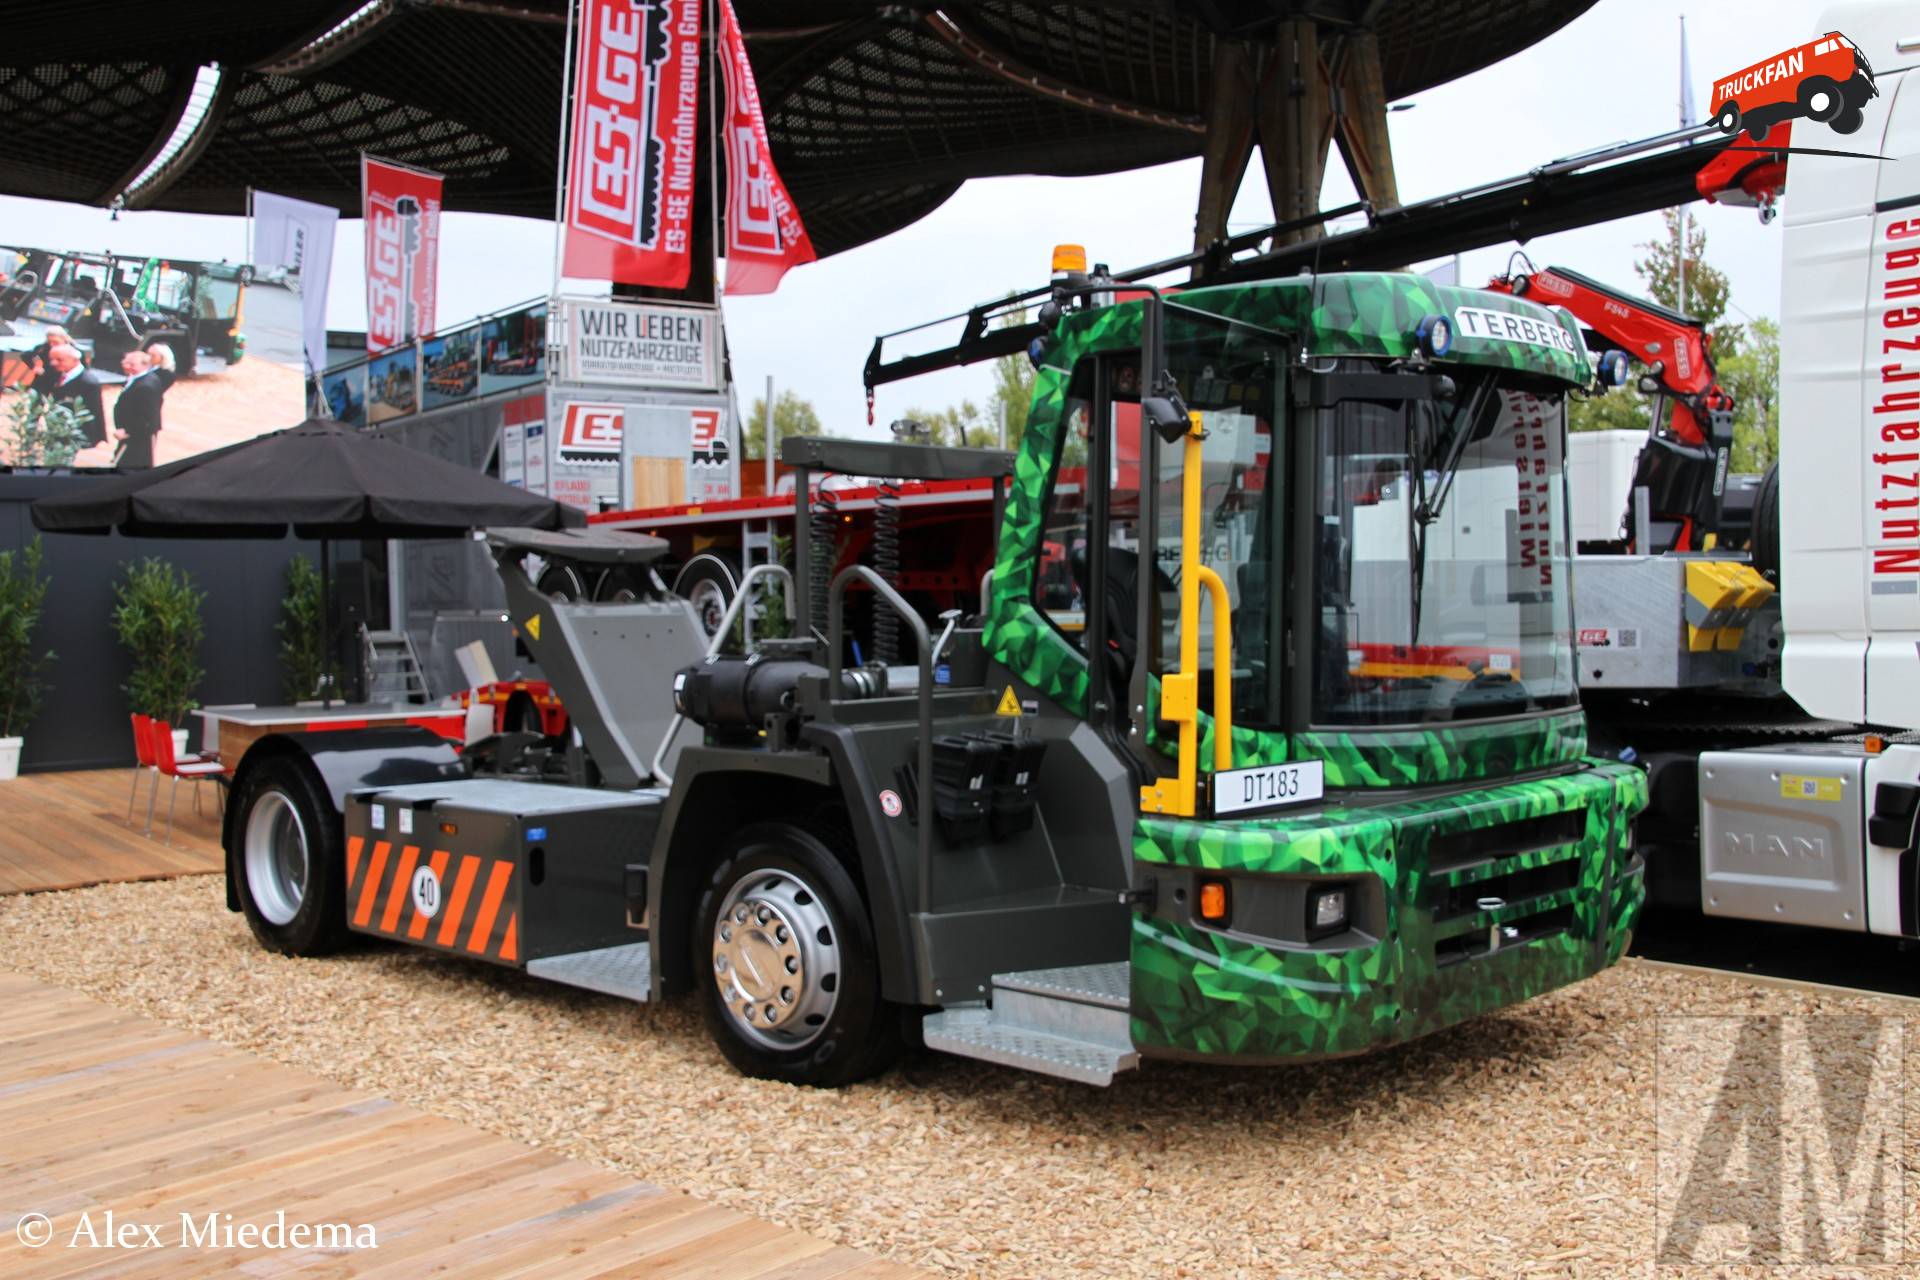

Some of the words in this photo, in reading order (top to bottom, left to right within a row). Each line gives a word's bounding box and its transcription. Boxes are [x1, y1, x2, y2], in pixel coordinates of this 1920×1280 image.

[668, 41, 699, 192] Nutzfahrzeuge
[665, 194, 690, 253] ES-GE
[580, 308, 628, 337] WIR
[1460, 310, 1576, 353] TERBERG
[580, 338, 702, 365] NUTZFAHRZEUGE
[1873, 218, 1920, 574] Nutzfahrzeuge
[1243, 769, 1299, 803] DT183
[1725, 831, 1824, 860] MAN
[418, 875, 434, 907] 40
